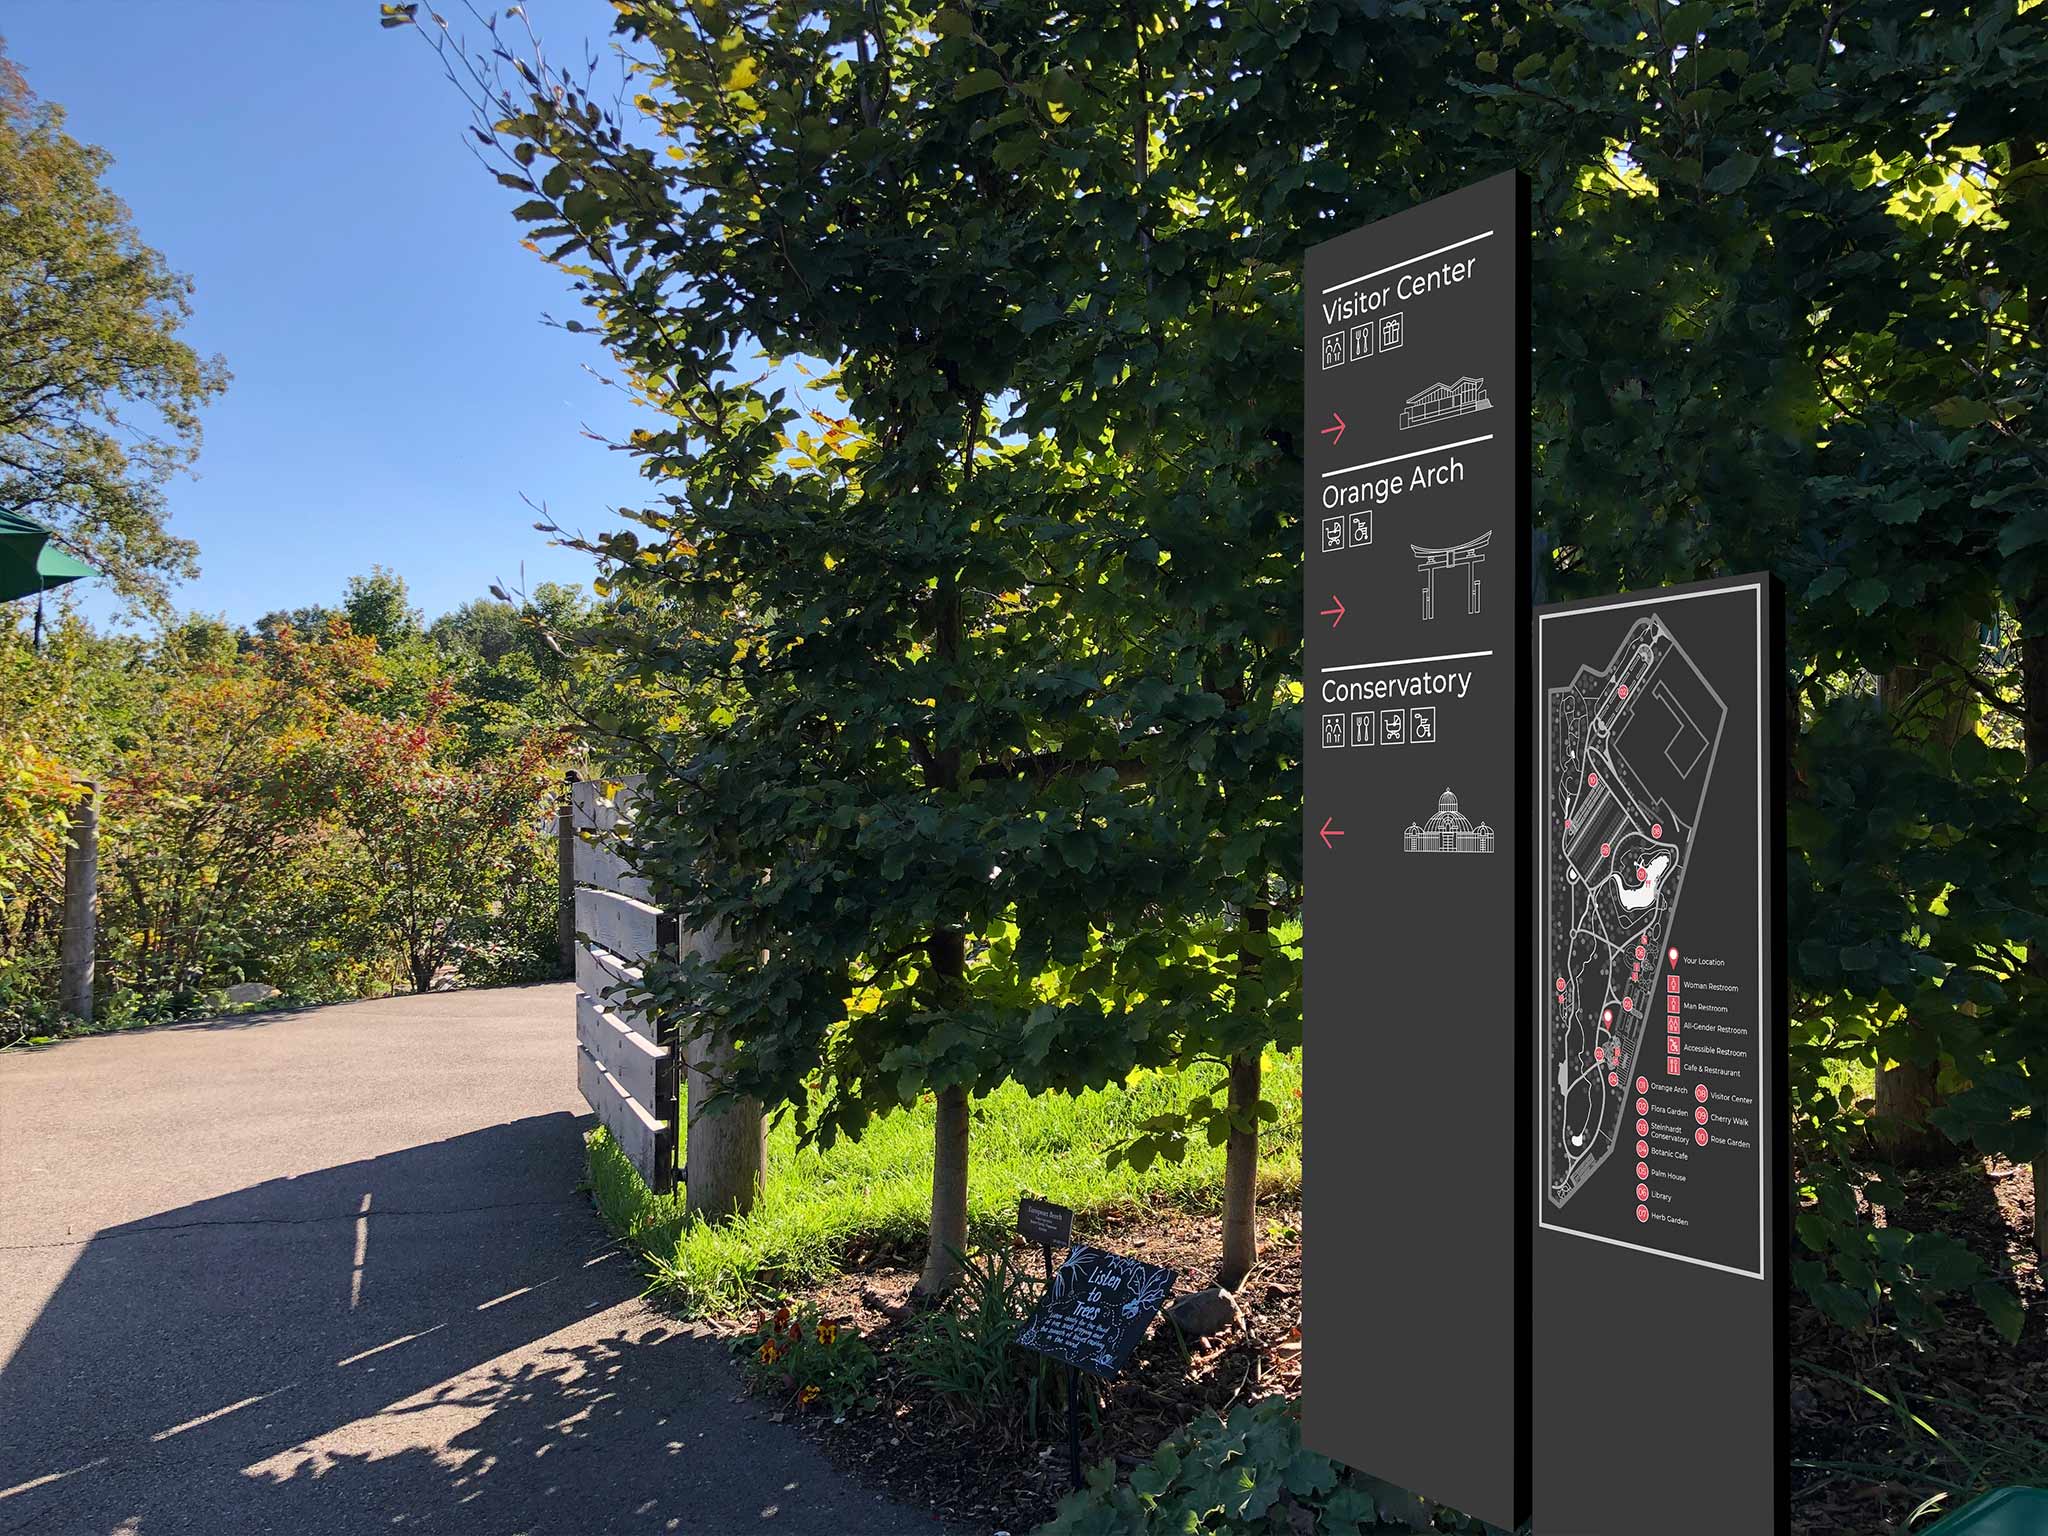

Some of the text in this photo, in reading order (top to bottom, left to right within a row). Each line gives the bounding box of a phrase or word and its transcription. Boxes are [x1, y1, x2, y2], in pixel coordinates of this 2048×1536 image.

[1322, 257, 1476, 325] Visitor Center
[1322, 457, 1464, 508] Orange Arch
[1322, 671, 1472, 702] Conservatory
[1683, 956, 1725, 966] Your Location
[1683, 981, 1739, 992] Woman Restroom
[1683, 1002, 1728, 1013] Man Restroom
[1683, 1022, 1748, 1035] All-Gender Restroom
[1683, 1044, 1747, 1058] Accessible Restroom
[1683, 1063, 1698, 1072] Cafe
[1651, 1082, 1673, 1093] Orange
[1673, 1085, 1688, 1094] Arch
[1710, 1091, 1730, 1101] Visitor
[1731, 1094, 1753, 1105] Center
[1651, 1104, 1666, 1114] Flora
[1667, 1106, 1689, 1117] Garden
[1710, 1114, 1732, 1126] Cherry
[1732, 1117, 1749, 1126] Walk
[1650, 1122, 1682, 1133] Steinhardt
[1651, 1131, 1690, 1145] Conservatory
[1710, 1135, 1726, 1145] Rose
[1727, 1138, 1751, 1149] Garden
[1651, 1147, 1674, 1158] Botanic
[1674, 1151, 1688, 1160] Cafe
[1651, 1168, 1666, 1178] Palm
[1667, 1171, 1686, 1182] House
[1651, 1191, 1672, 1202] Library
[1651, 1212, 1666, 1222] Herb
[1666, 1215, 1689, 1226] Garden
[1087, 1266, 1122, 1291] Listen
[1087, 1287, 1102, 1302] to
[1073, 1300, 1101, 1320] Trees
